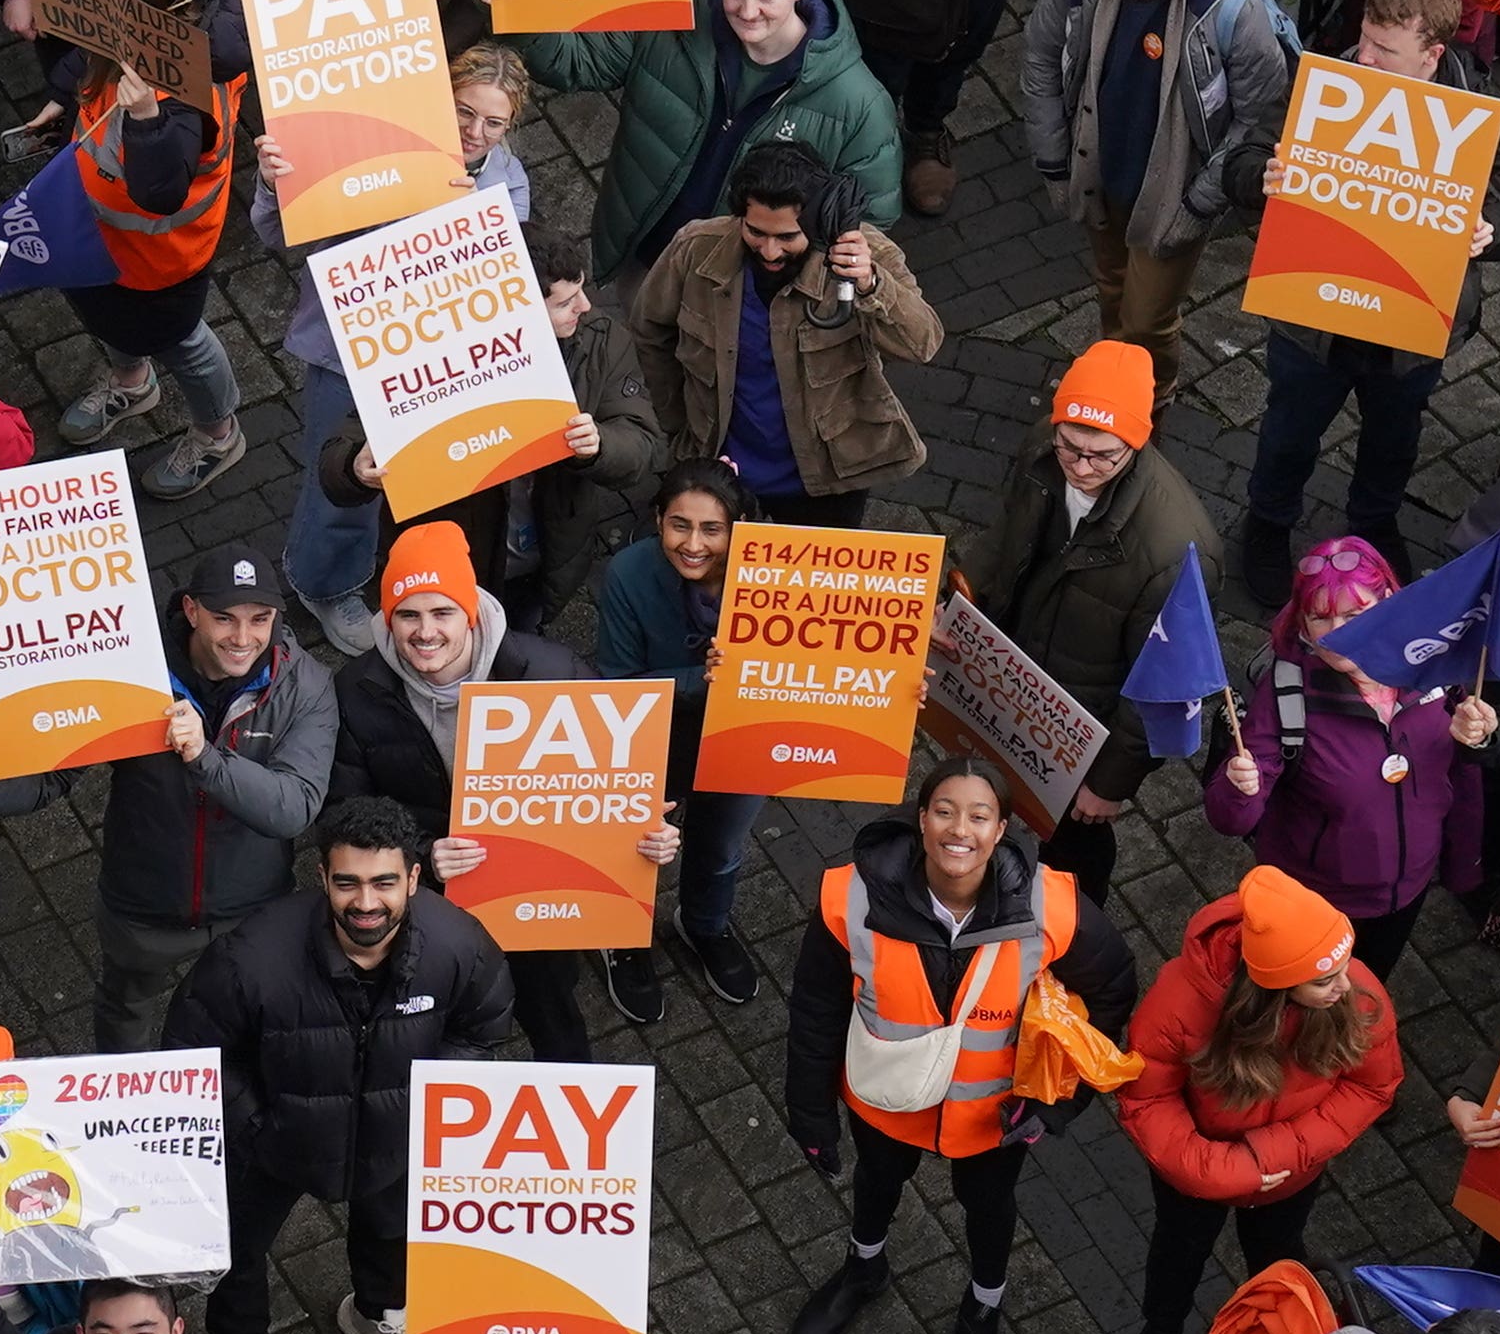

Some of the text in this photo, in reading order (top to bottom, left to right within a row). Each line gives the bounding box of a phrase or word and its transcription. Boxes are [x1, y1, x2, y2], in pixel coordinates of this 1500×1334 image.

[424, 1083, 638, 1171] PAY
[422, 1175, 636, 1195] RESTORATION FOR
[422, 1200, 635, 1235] DOCTORS
